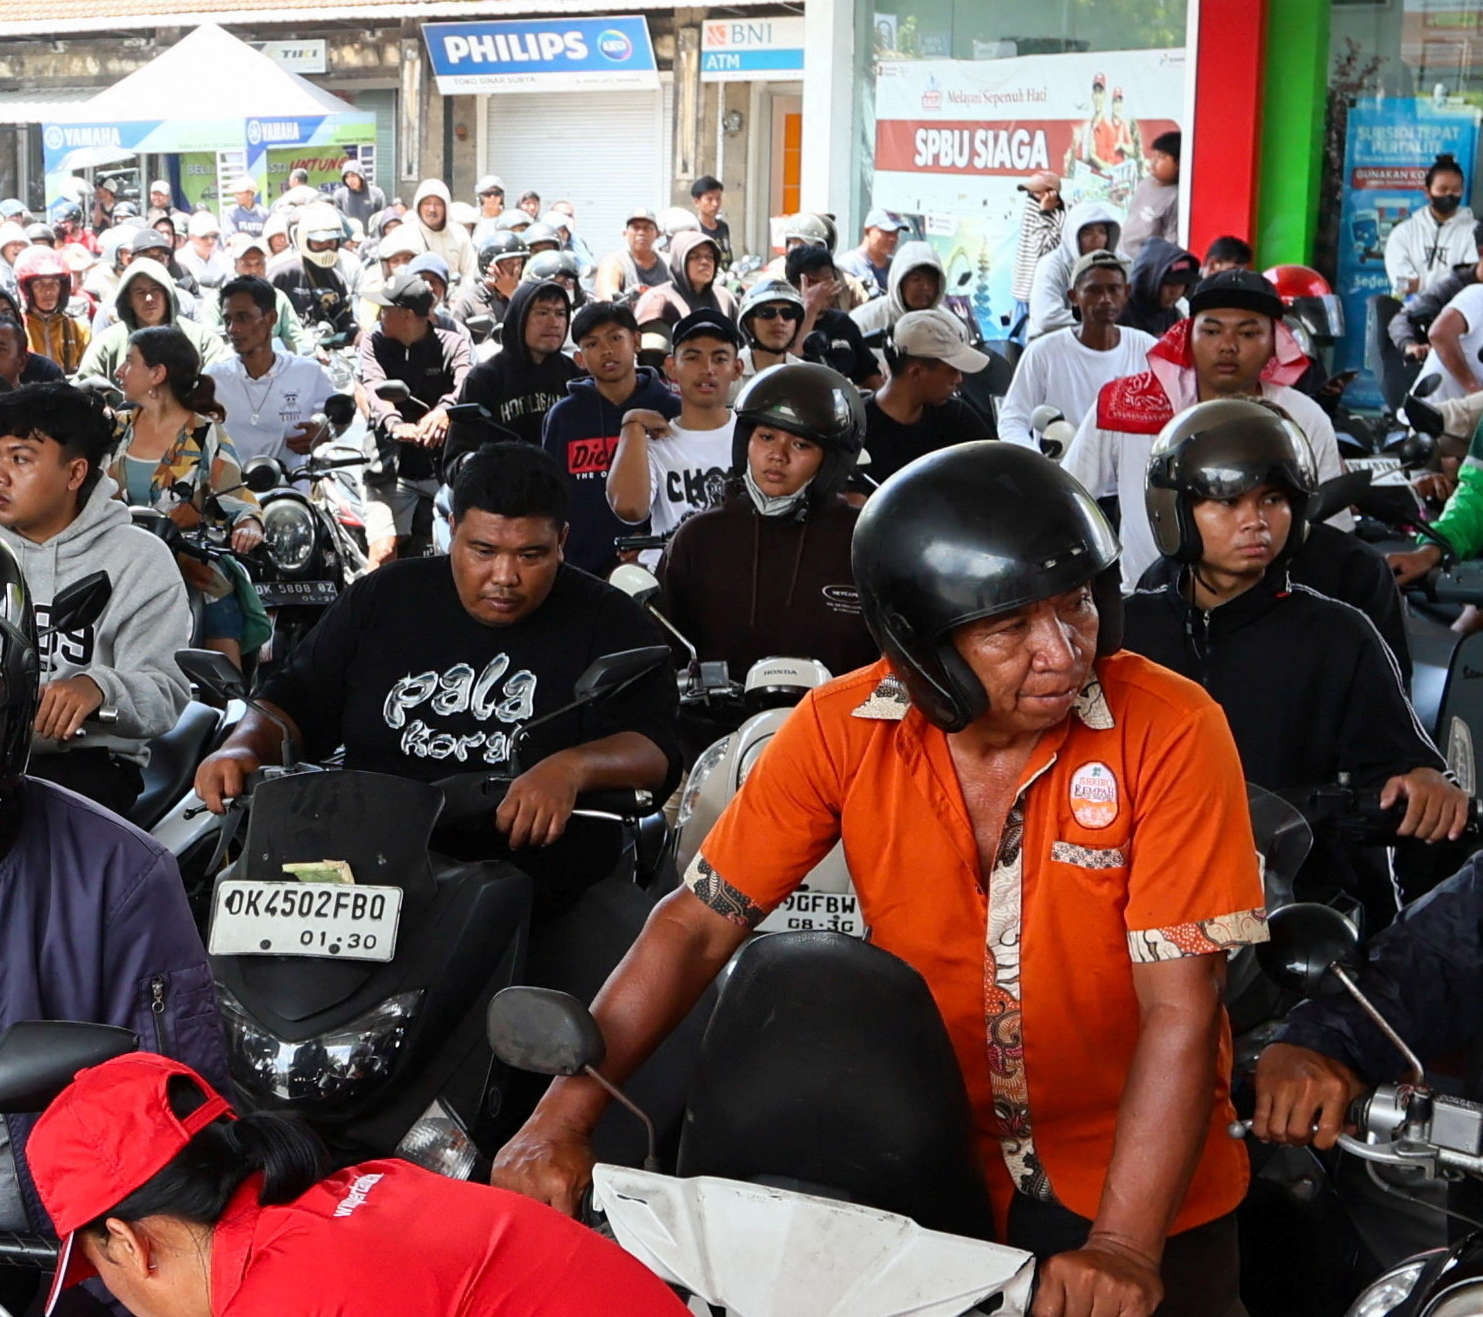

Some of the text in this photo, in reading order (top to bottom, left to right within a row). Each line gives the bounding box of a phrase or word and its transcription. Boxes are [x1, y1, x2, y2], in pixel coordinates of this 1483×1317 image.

[731, 23, 773, 44] BNI
[443, 31, 588, 64] PHILIPS
[706, 54, 741, 69] ATM
[982, 89, 1024, 105] Sepenuh
[1026, 87, 1048, 103] Hati
[64, 127, 122, 147] YAMAHA
[262, 121, 300, 142] YAMAHA
[914, 128, 1050, 170] SPBU SIAGA
[1356, 168, 1407, 180] GUNAKAN
[383, 653, 537, 729] pala
[1075, 784, 1115, 798] REMPAH
